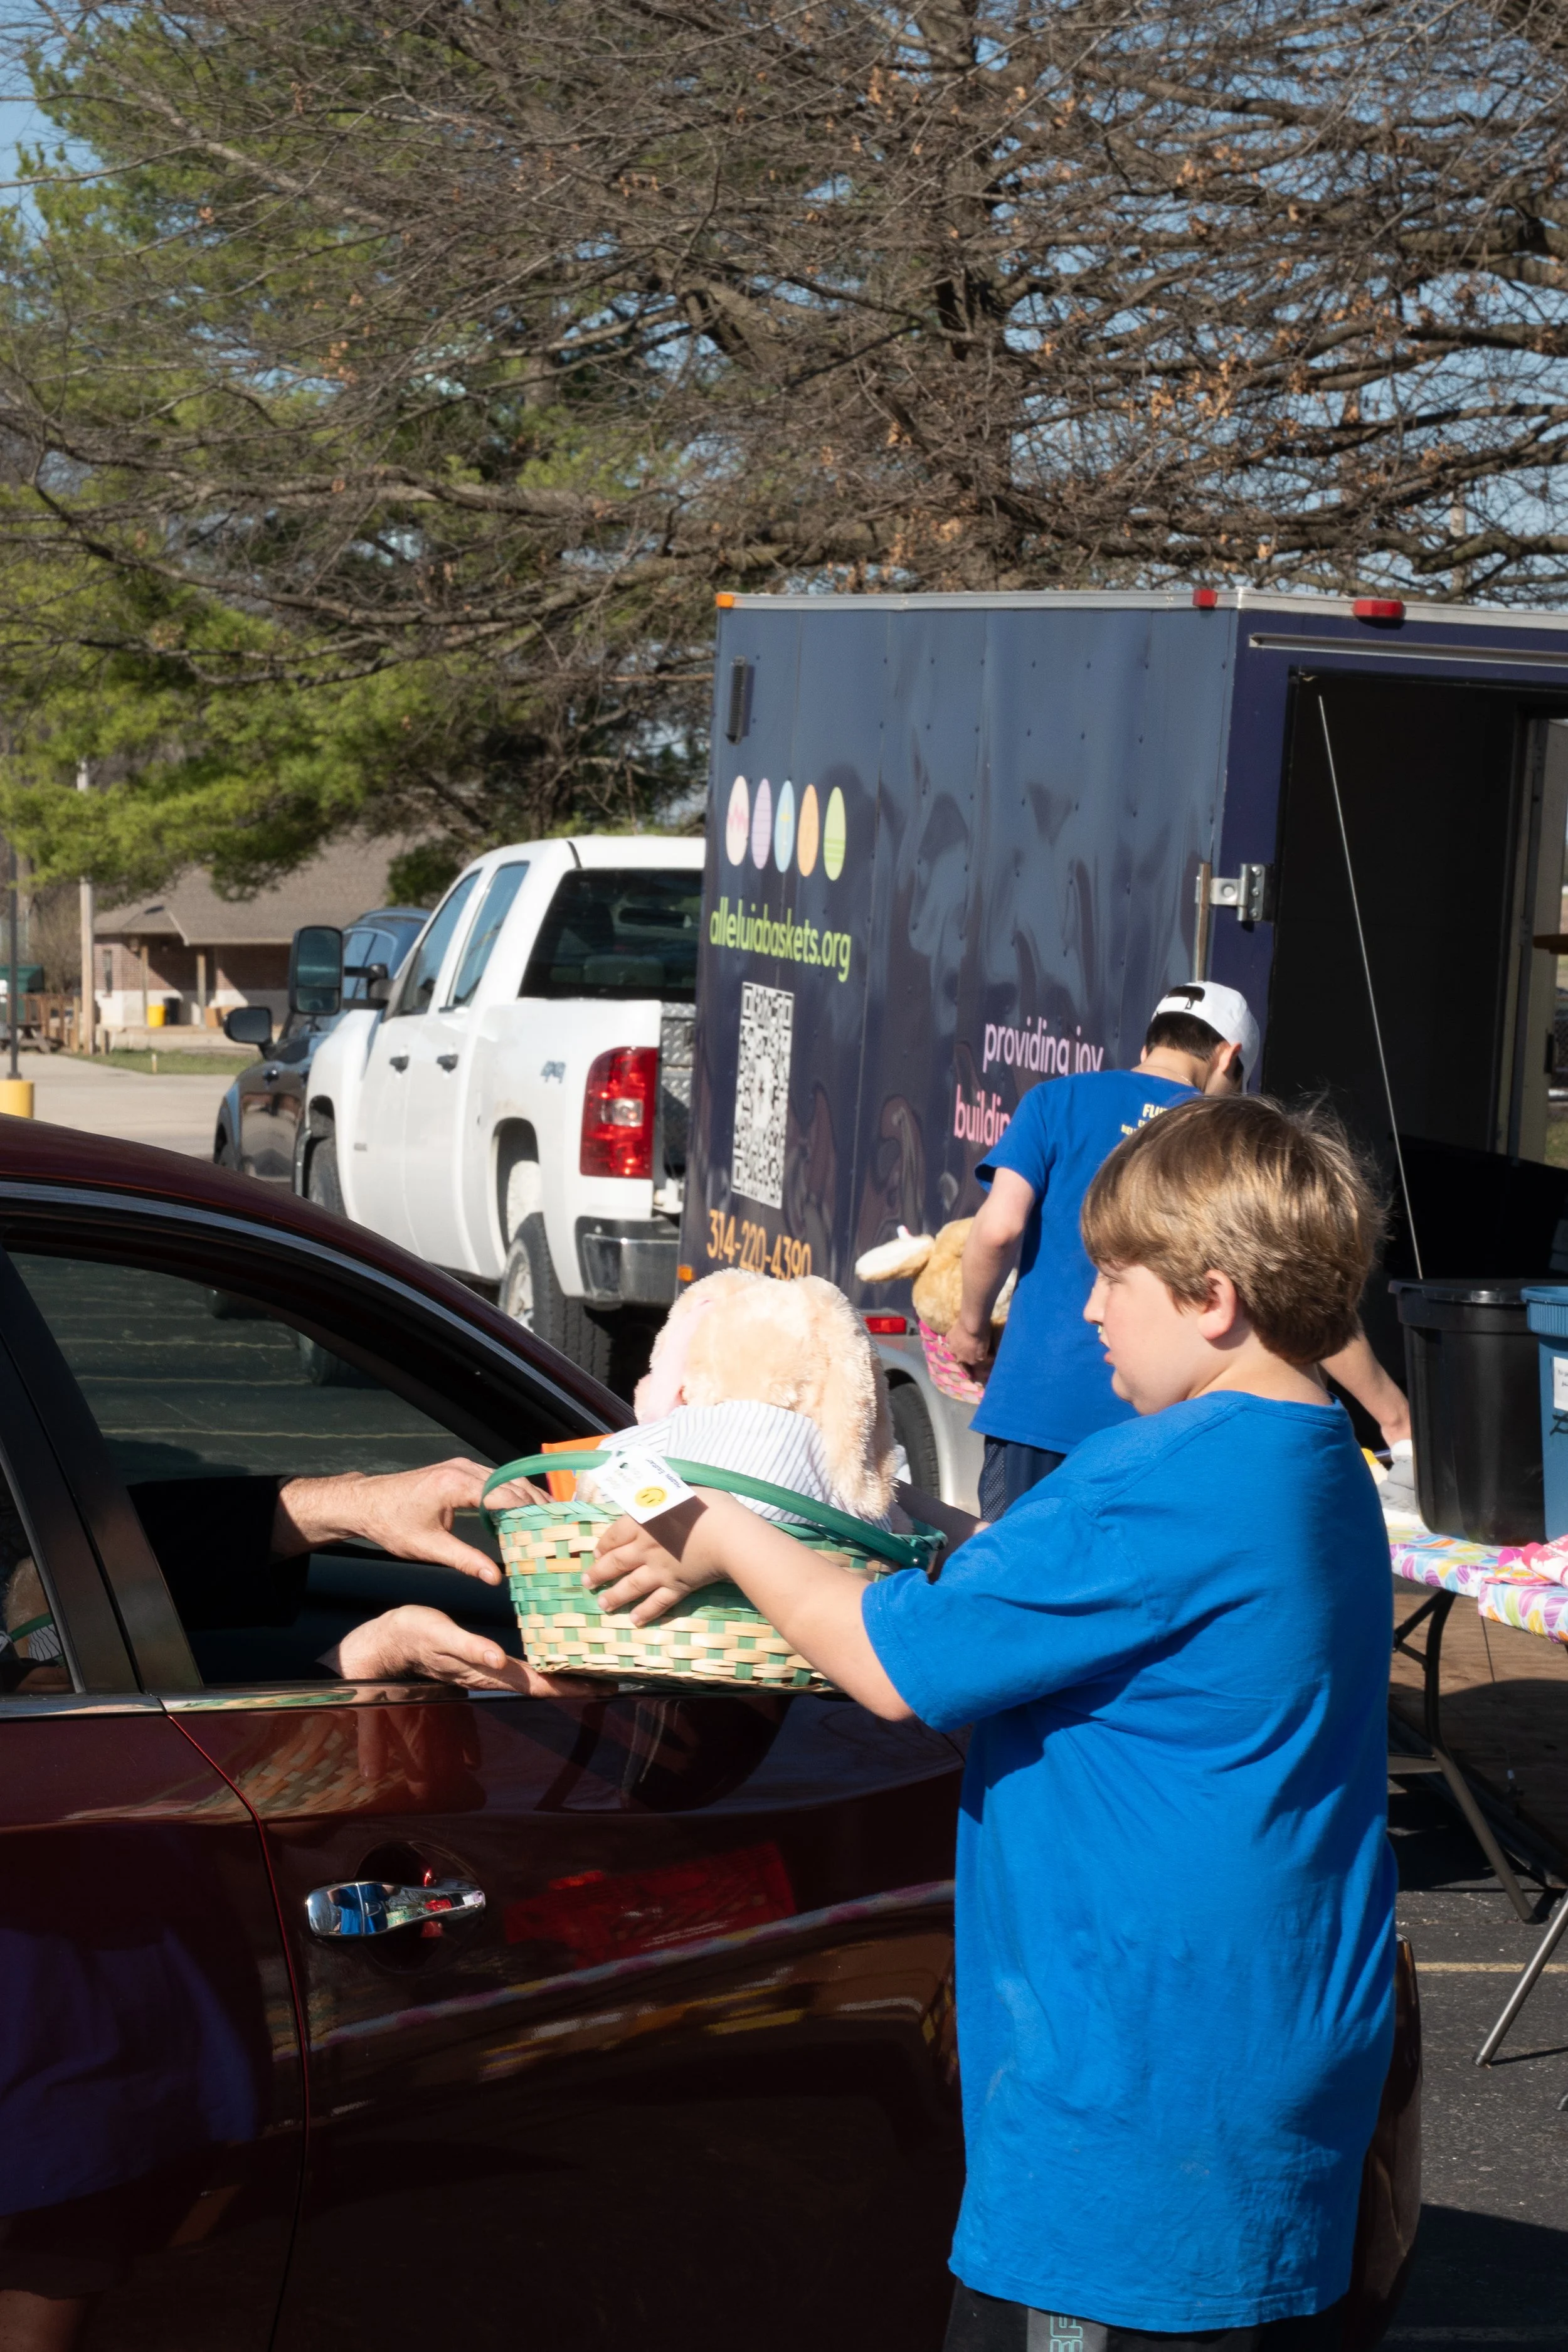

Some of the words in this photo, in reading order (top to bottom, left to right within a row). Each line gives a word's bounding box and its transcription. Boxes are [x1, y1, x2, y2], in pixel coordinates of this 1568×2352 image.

[709, 896, 852, 983] alleluiabaskets.org
[982, 1016, 1070, 1077] providing
[1074, 1025, 1104, 1074] joy
[953, 1084, 1012, 1147] buildin
[706, 1209, 812, 1282] 314-220-4390
